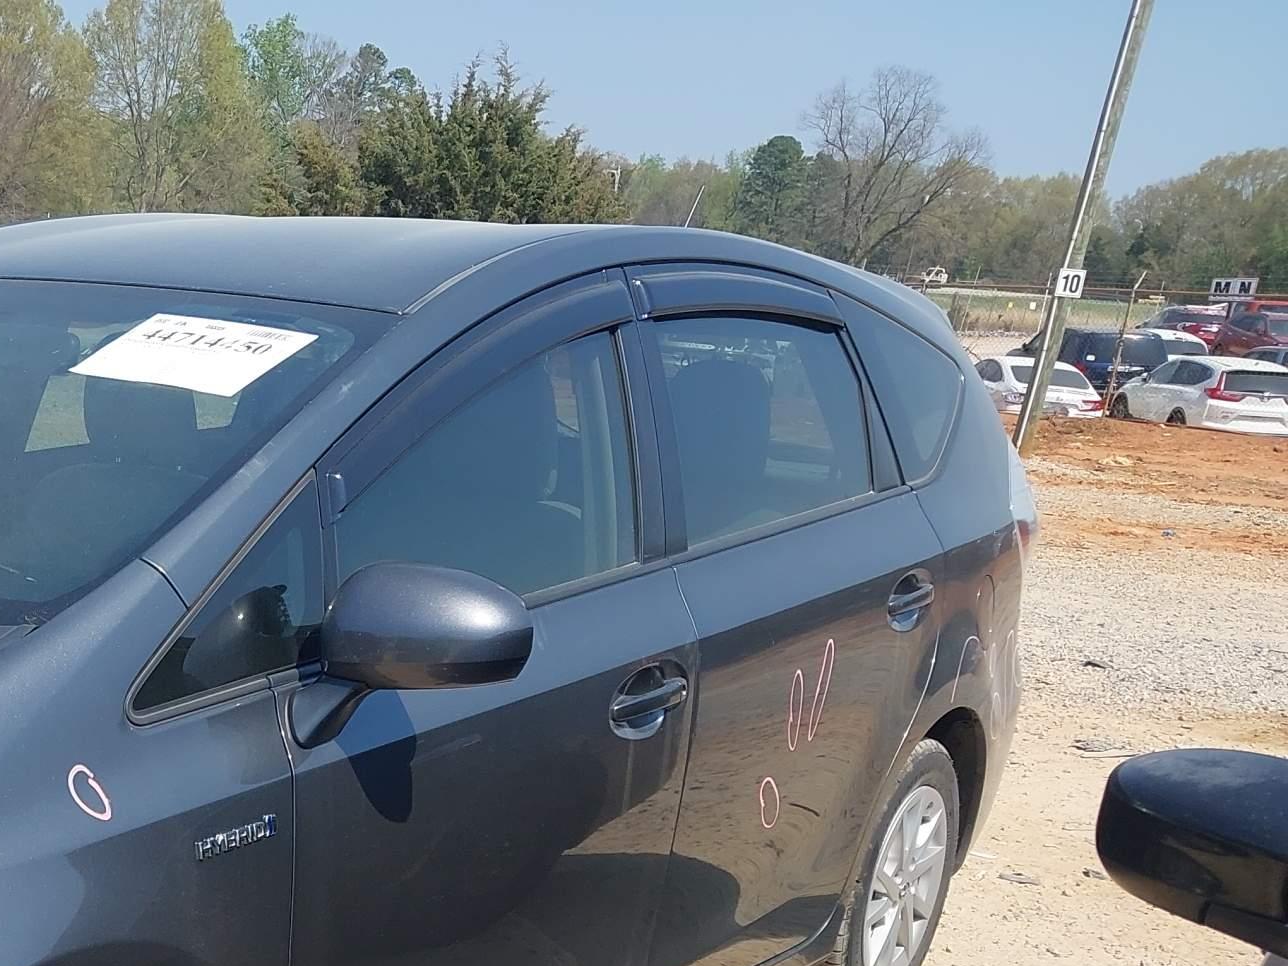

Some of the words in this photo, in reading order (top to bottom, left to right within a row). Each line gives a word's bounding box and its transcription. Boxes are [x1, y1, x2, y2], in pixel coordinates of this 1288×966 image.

[1062, 273, 1081, 293] 10
[1214, 281, 1232, 294] M
[1239, 281, 1253, 294] N
[194, 820, 267, 861] HYBRID
